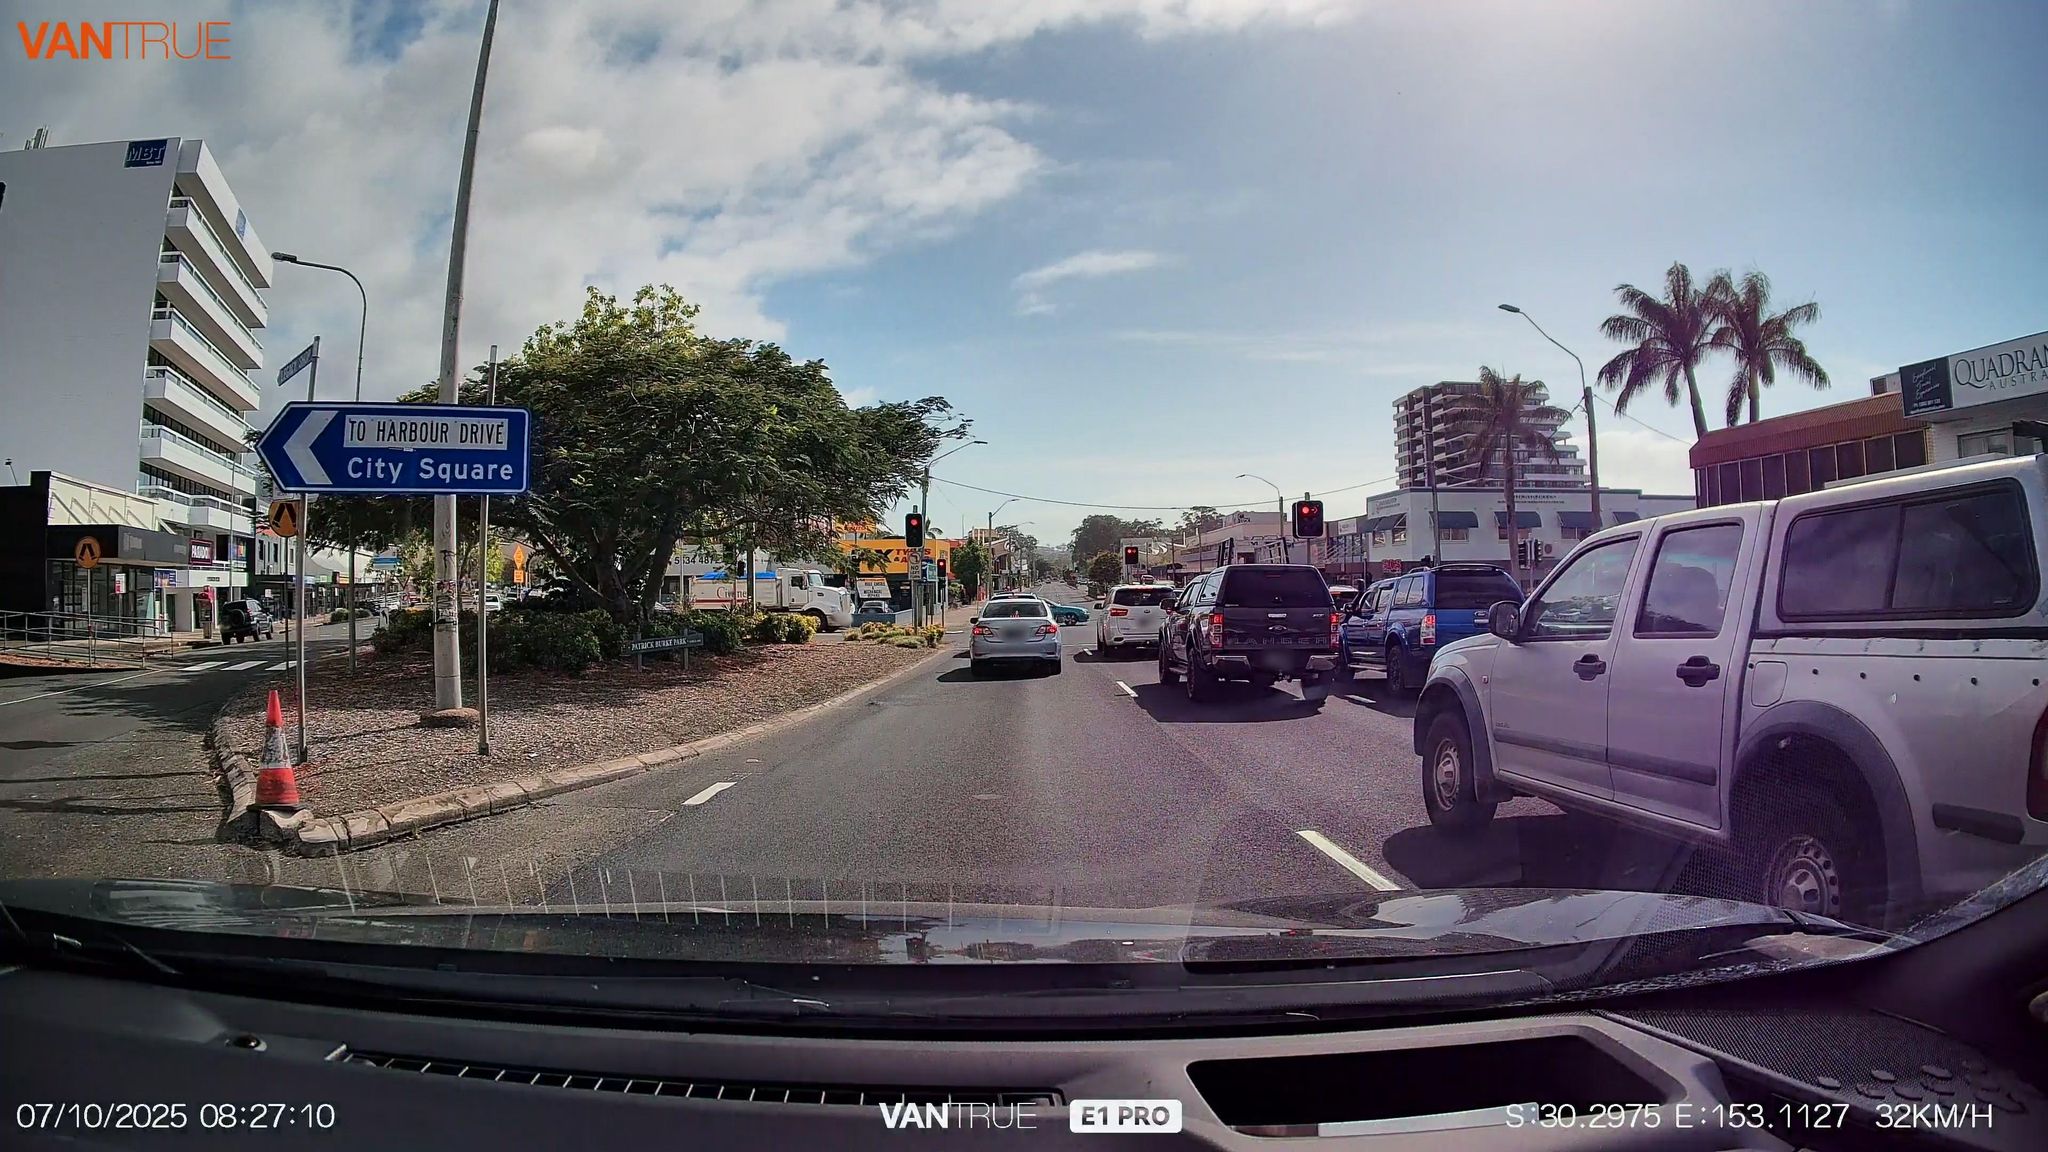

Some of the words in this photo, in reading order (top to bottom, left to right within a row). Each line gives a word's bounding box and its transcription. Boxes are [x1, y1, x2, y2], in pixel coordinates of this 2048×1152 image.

[126, 146, 166, 161] MBT
[349, 419, 366, 442] TO
[376, 420, 449, 444] HARBOUR
[459, 422, 504, 445] DRIVE
[347, 456, 403, 484] City
[419, 457, 513, 484] Square
[631, 641, 655, 651] PATRICK
[673, 637, 687, 646] PARK
